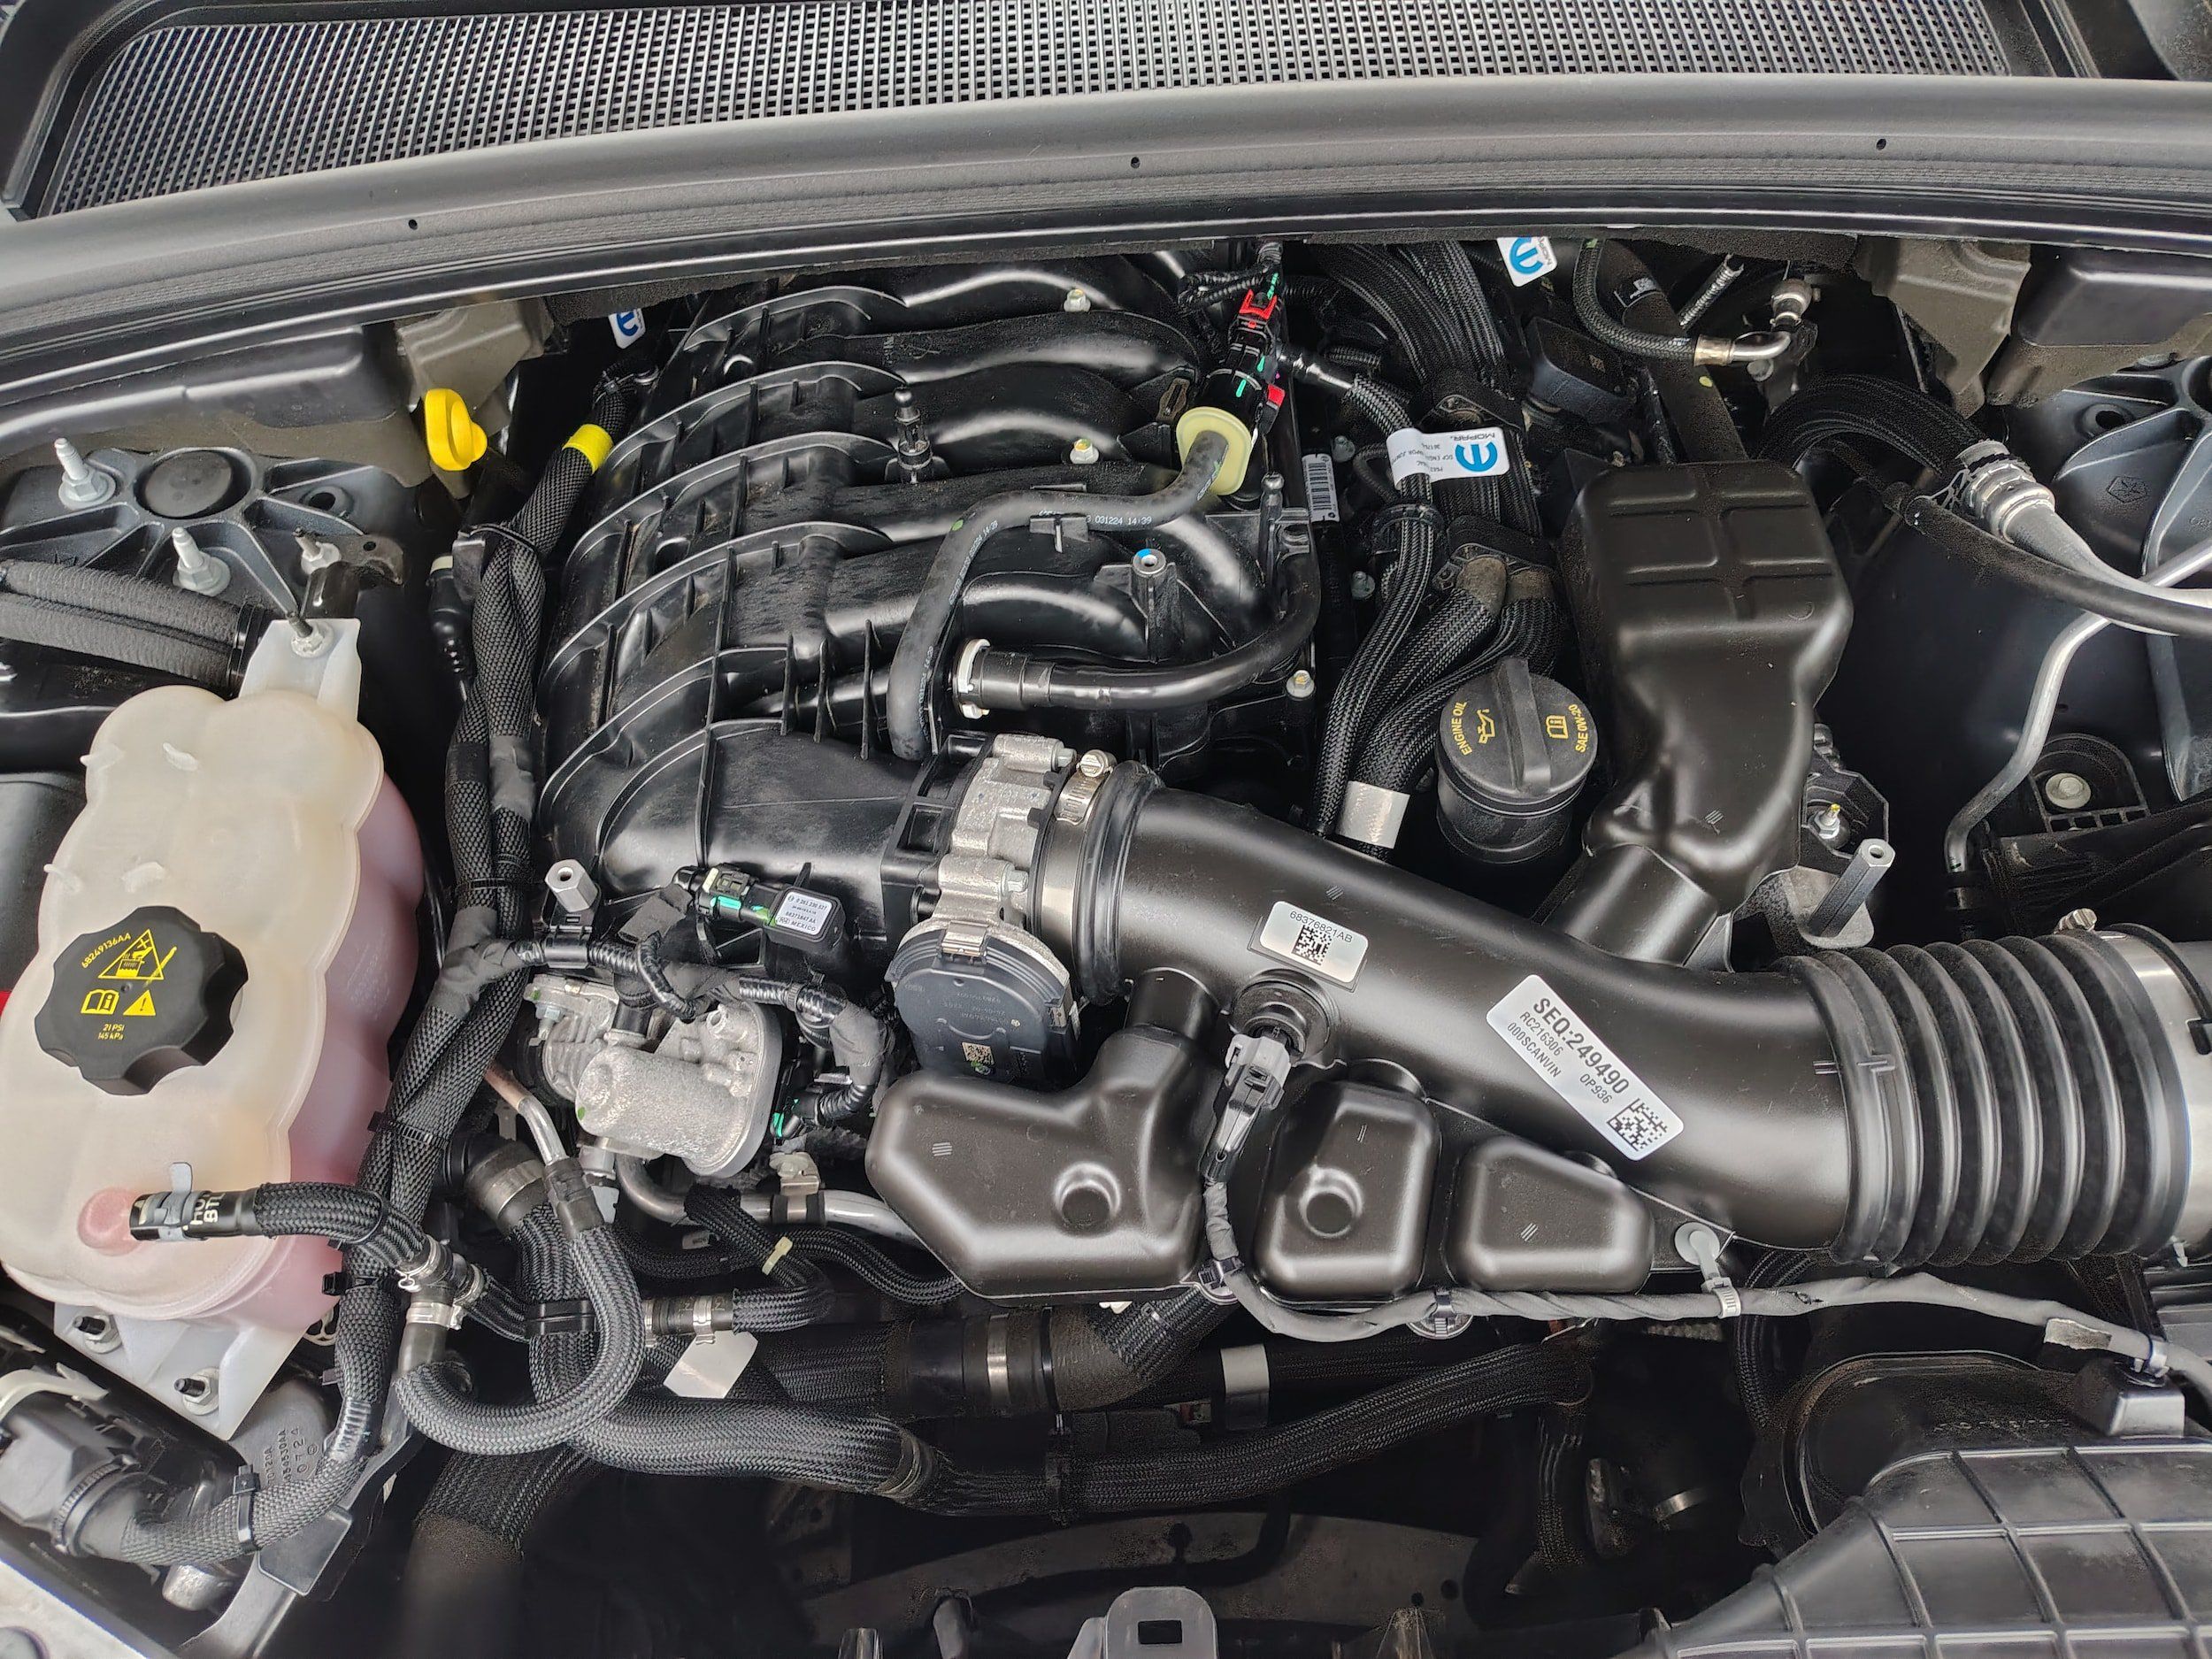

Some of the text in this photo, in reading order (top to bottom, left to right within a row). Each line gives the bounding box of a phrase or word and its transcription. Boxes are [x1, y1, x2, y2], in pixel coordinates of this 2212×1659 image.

[1094, 515, 1123, 525] 031224
[1451, 701, 1472, 756] ENGINE OIL
[1568, 703, 1588, 753] SAE 0W-20
[791, 920, 816, 932] MEXICO
[1289, 910, 1353, 943] 68376821AB
[81, 933, 132, 969] 68249136AA
[103, 1023, 125, 1032] 21 PSI
[1519, 1011, 1563, 1056] RC216306
[1533, 997, 1629, 1094] SEQ:249490
[1507, 1022, 1562, 1078] 000SCANVIN
